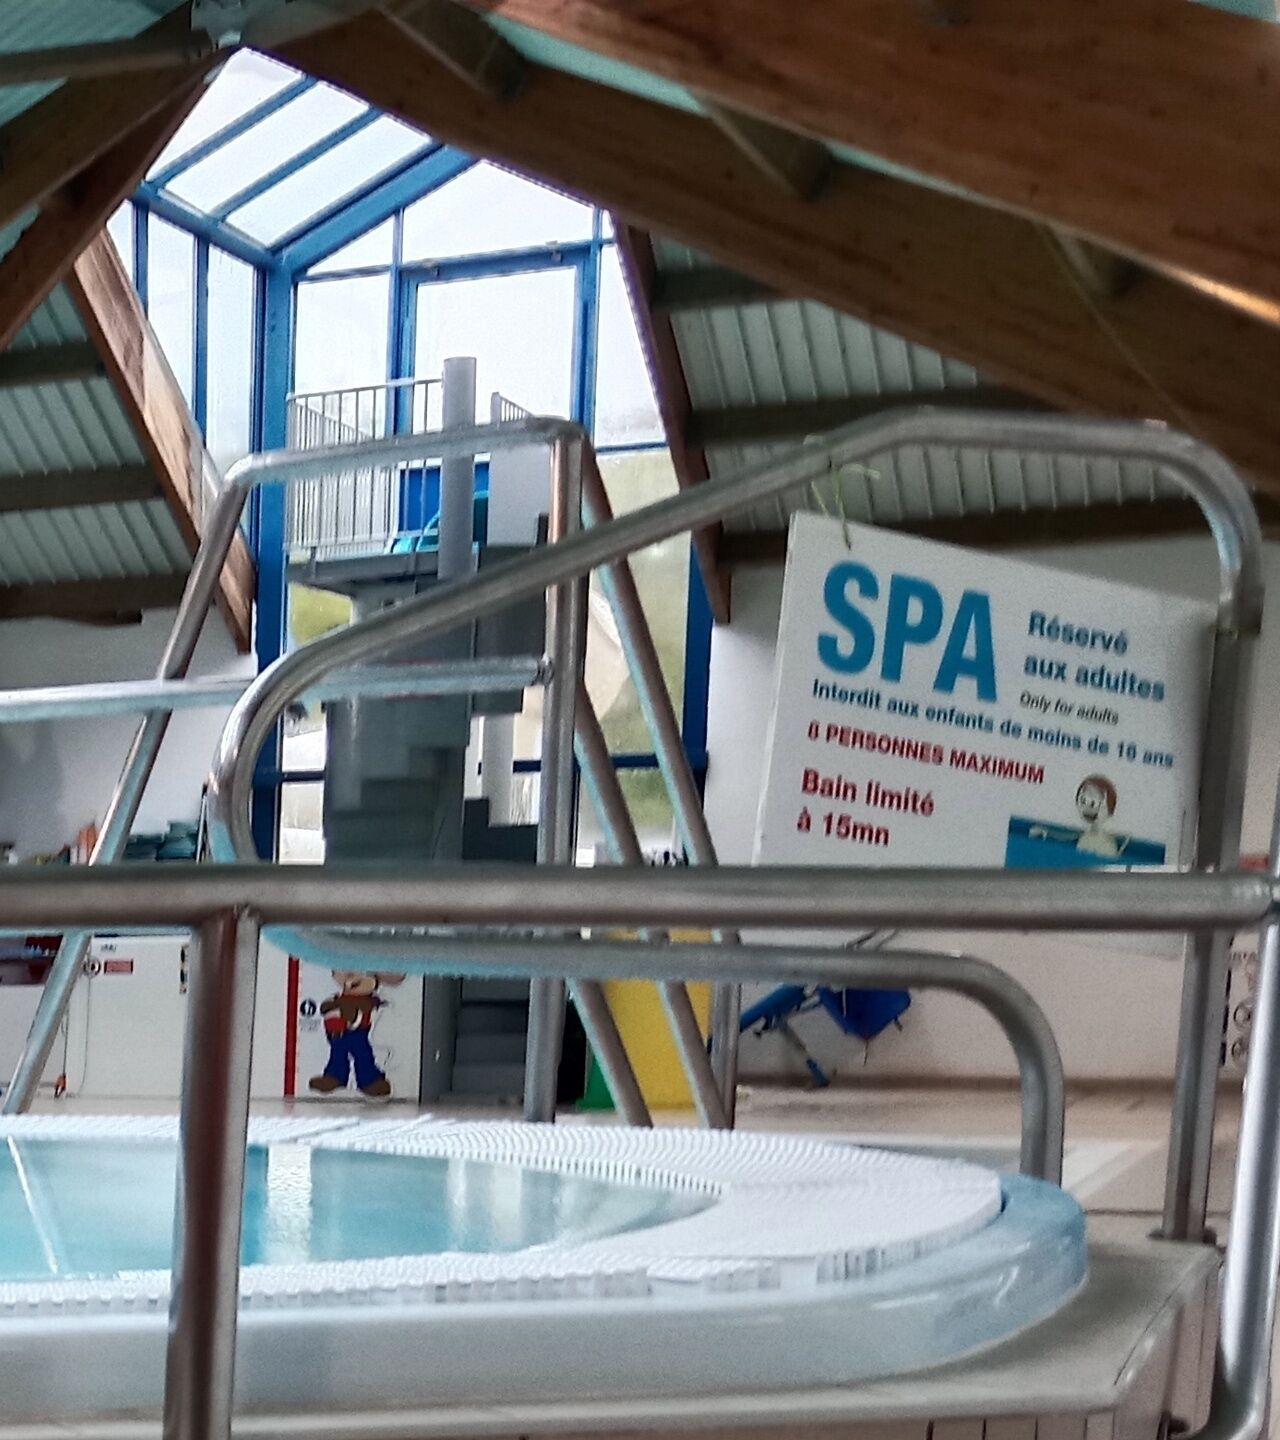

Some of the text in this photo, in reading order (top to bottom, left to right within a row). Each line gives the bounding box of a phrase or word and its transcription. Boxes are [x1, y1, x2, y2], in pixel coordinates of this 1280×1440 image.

[817, 560, 998, 703] SPA
[1028, 610, 1129, 656] Réservé
[1023, 654, 1165, 701] aux adultes
[812, 678, 882, 712] Interdit
[887, 698, 919, 718] aux
[925, 705, 994, 733] enfants
[1000, 718, 1022, 739] de
[1027, 725, 1082, 752] moins
[1087, 734, 1109, 755] de
[1142, 751, 1175, 770] ans
[1019, 689, 1120, 726] Only for adults
[825, 723, 944, 766] PERSONNES
[949, 747, 1045, 785] MAXIMUM
[801, 766, 935, 818] Bain limité
[796, 806, 891, 848] à 15mn
